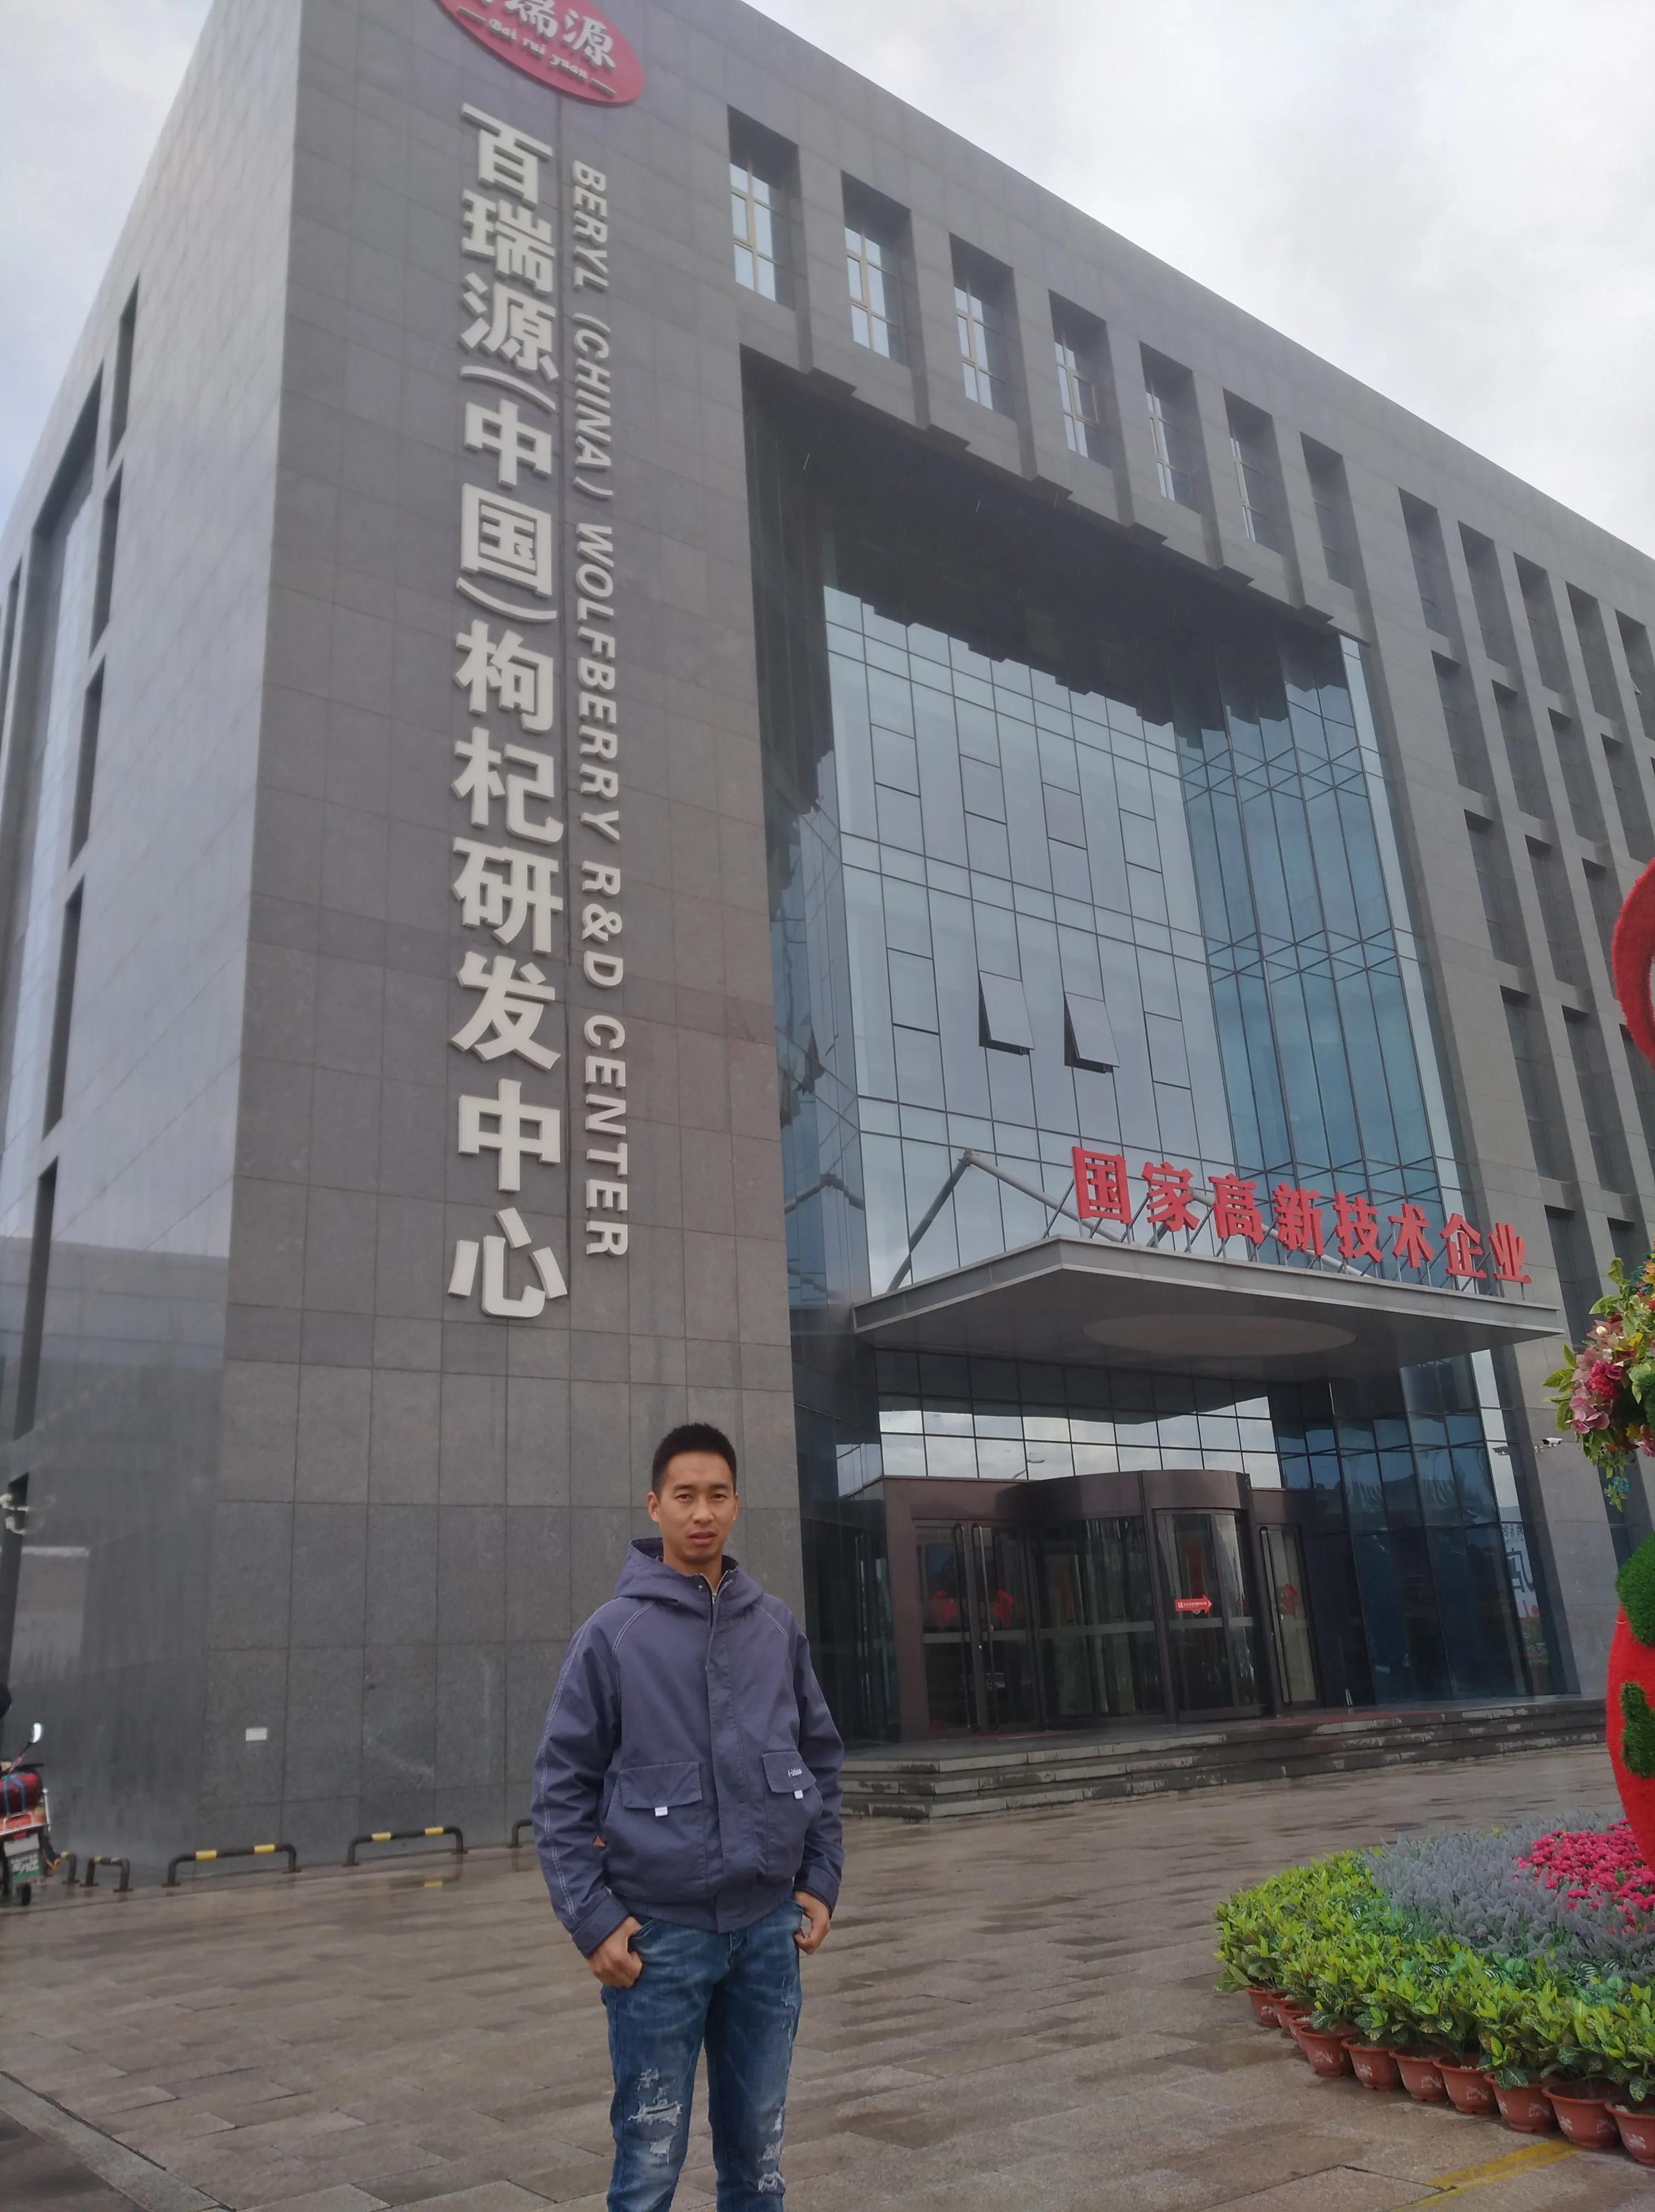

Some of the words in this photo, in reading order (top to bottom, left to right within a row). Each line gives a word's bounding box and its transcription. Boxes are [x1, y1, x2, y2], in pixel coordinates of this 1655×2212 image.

[482, 0, 616, 68] 瑞源
[571, 160, 609, 290] BERYL
[572, 313, 613, 496] (CHINA)
[575, 522, 620, 841] WOLFBERRY
[581, 860, 623, 988] R&D
[583, 1015, 628, 1257] CENTER
[1071, 1146, 1532, 1284] 国家高新技术企业
